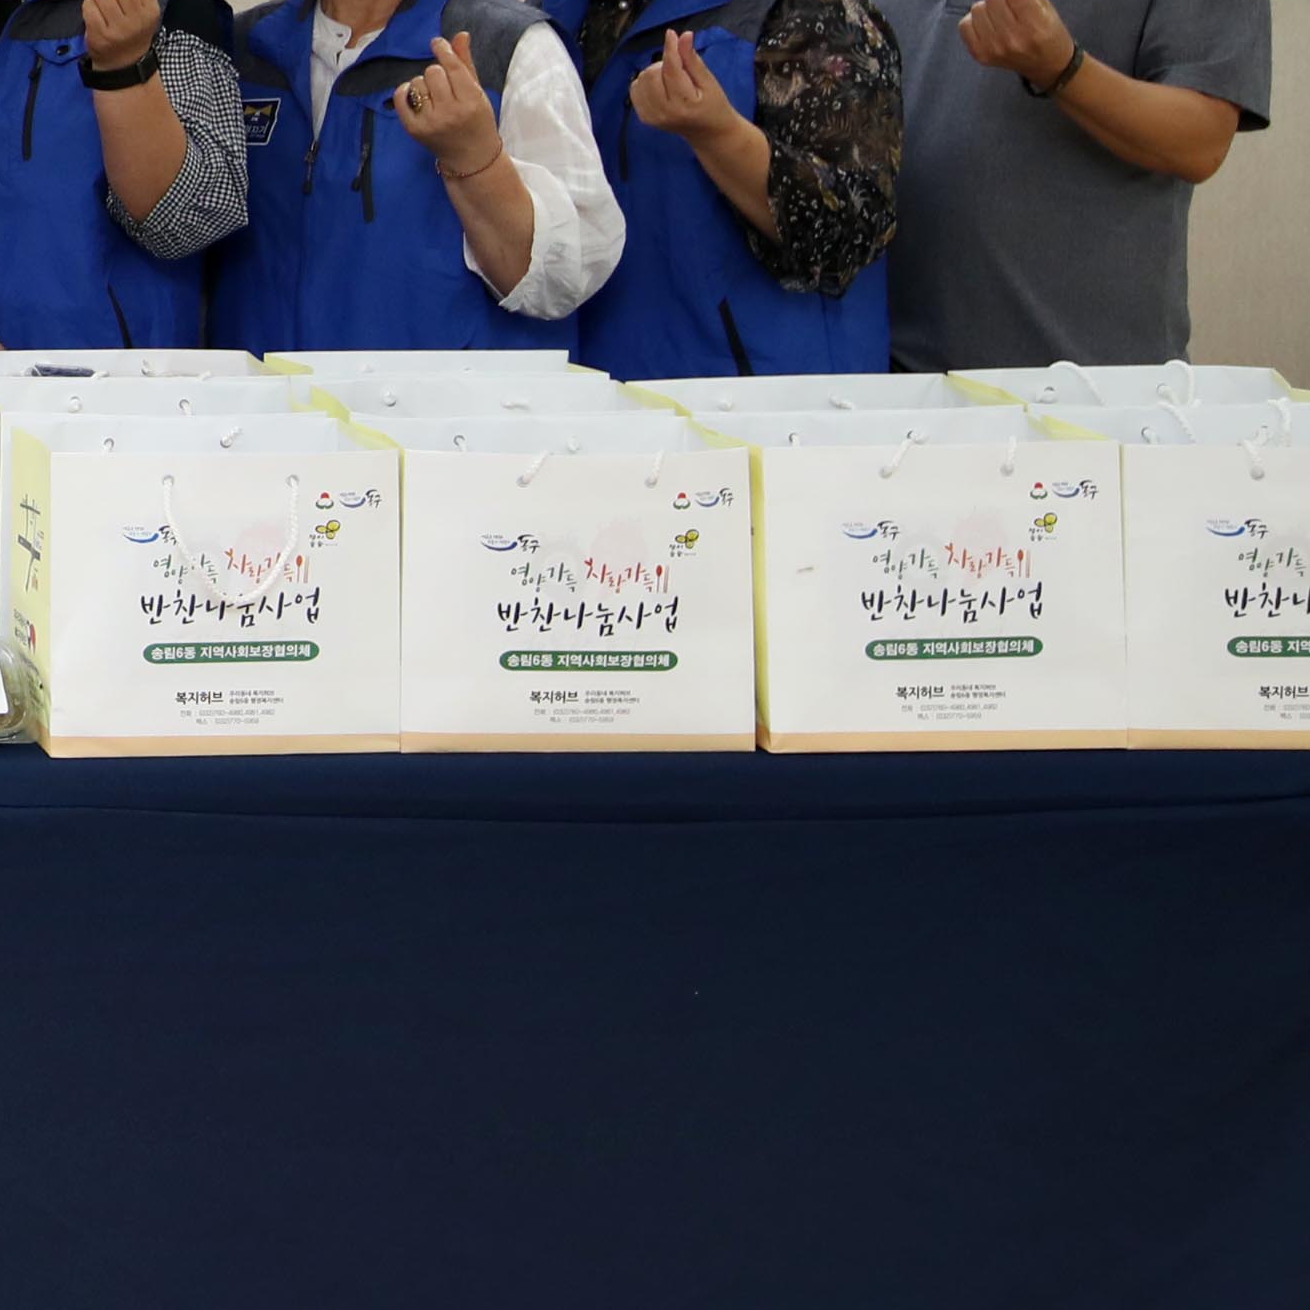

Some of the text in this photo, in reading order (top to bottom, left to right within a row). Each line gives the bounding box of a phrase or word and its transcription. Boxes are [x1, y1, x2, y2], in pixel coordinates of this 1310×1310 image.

[872, 548, 939, 579] 영양가득
[1238, 547, 1307, 577] 영양가득
[510, 562, 578, 594] 영양가득
[860, 581, 1043, 624] 반찬나눔사업
[497, 595, 679, 637] 반찬나눔사업
[150, 643, 311, 660] 송림6동 지역사회보장협의체
[506, 652, 671, 668] 송림6동 지역사회보장협의체
[175, 690, 224, 705] 복지허브
[529, 690, 580, 704] 복지허브
[895, 685, 945, 700] 복지허브
[1258, 685, 1310, 699] 복지허브
